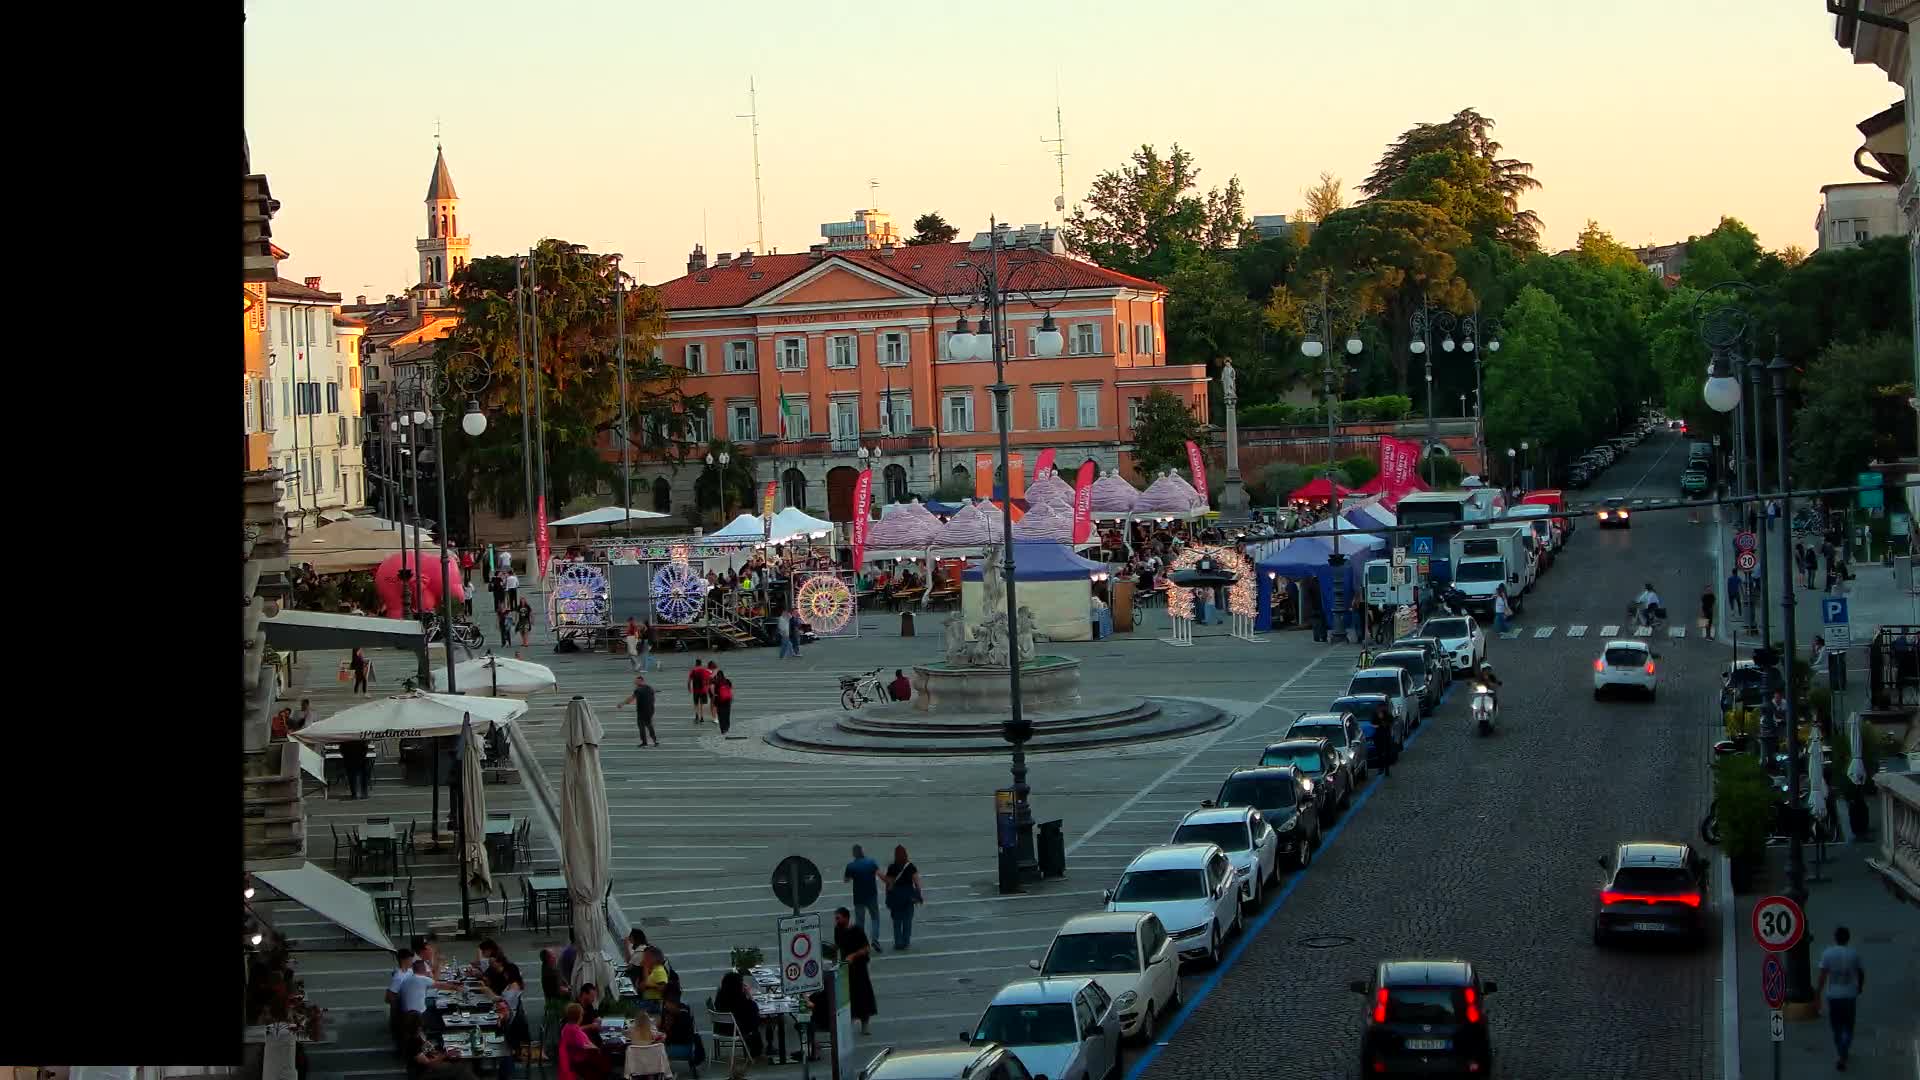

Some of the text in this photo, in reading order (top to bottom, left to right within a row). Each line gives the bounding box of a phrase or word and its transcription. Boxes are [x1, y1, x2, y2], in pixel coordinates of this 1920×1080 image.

[858, 477, 869, 515] PUGLIA
[1742, 557, 1753, 566] 20
[1828, 601, 1842, 622] P
[1762, 910, 1791, 937] 30
[789, 967, 798, 977] 20
